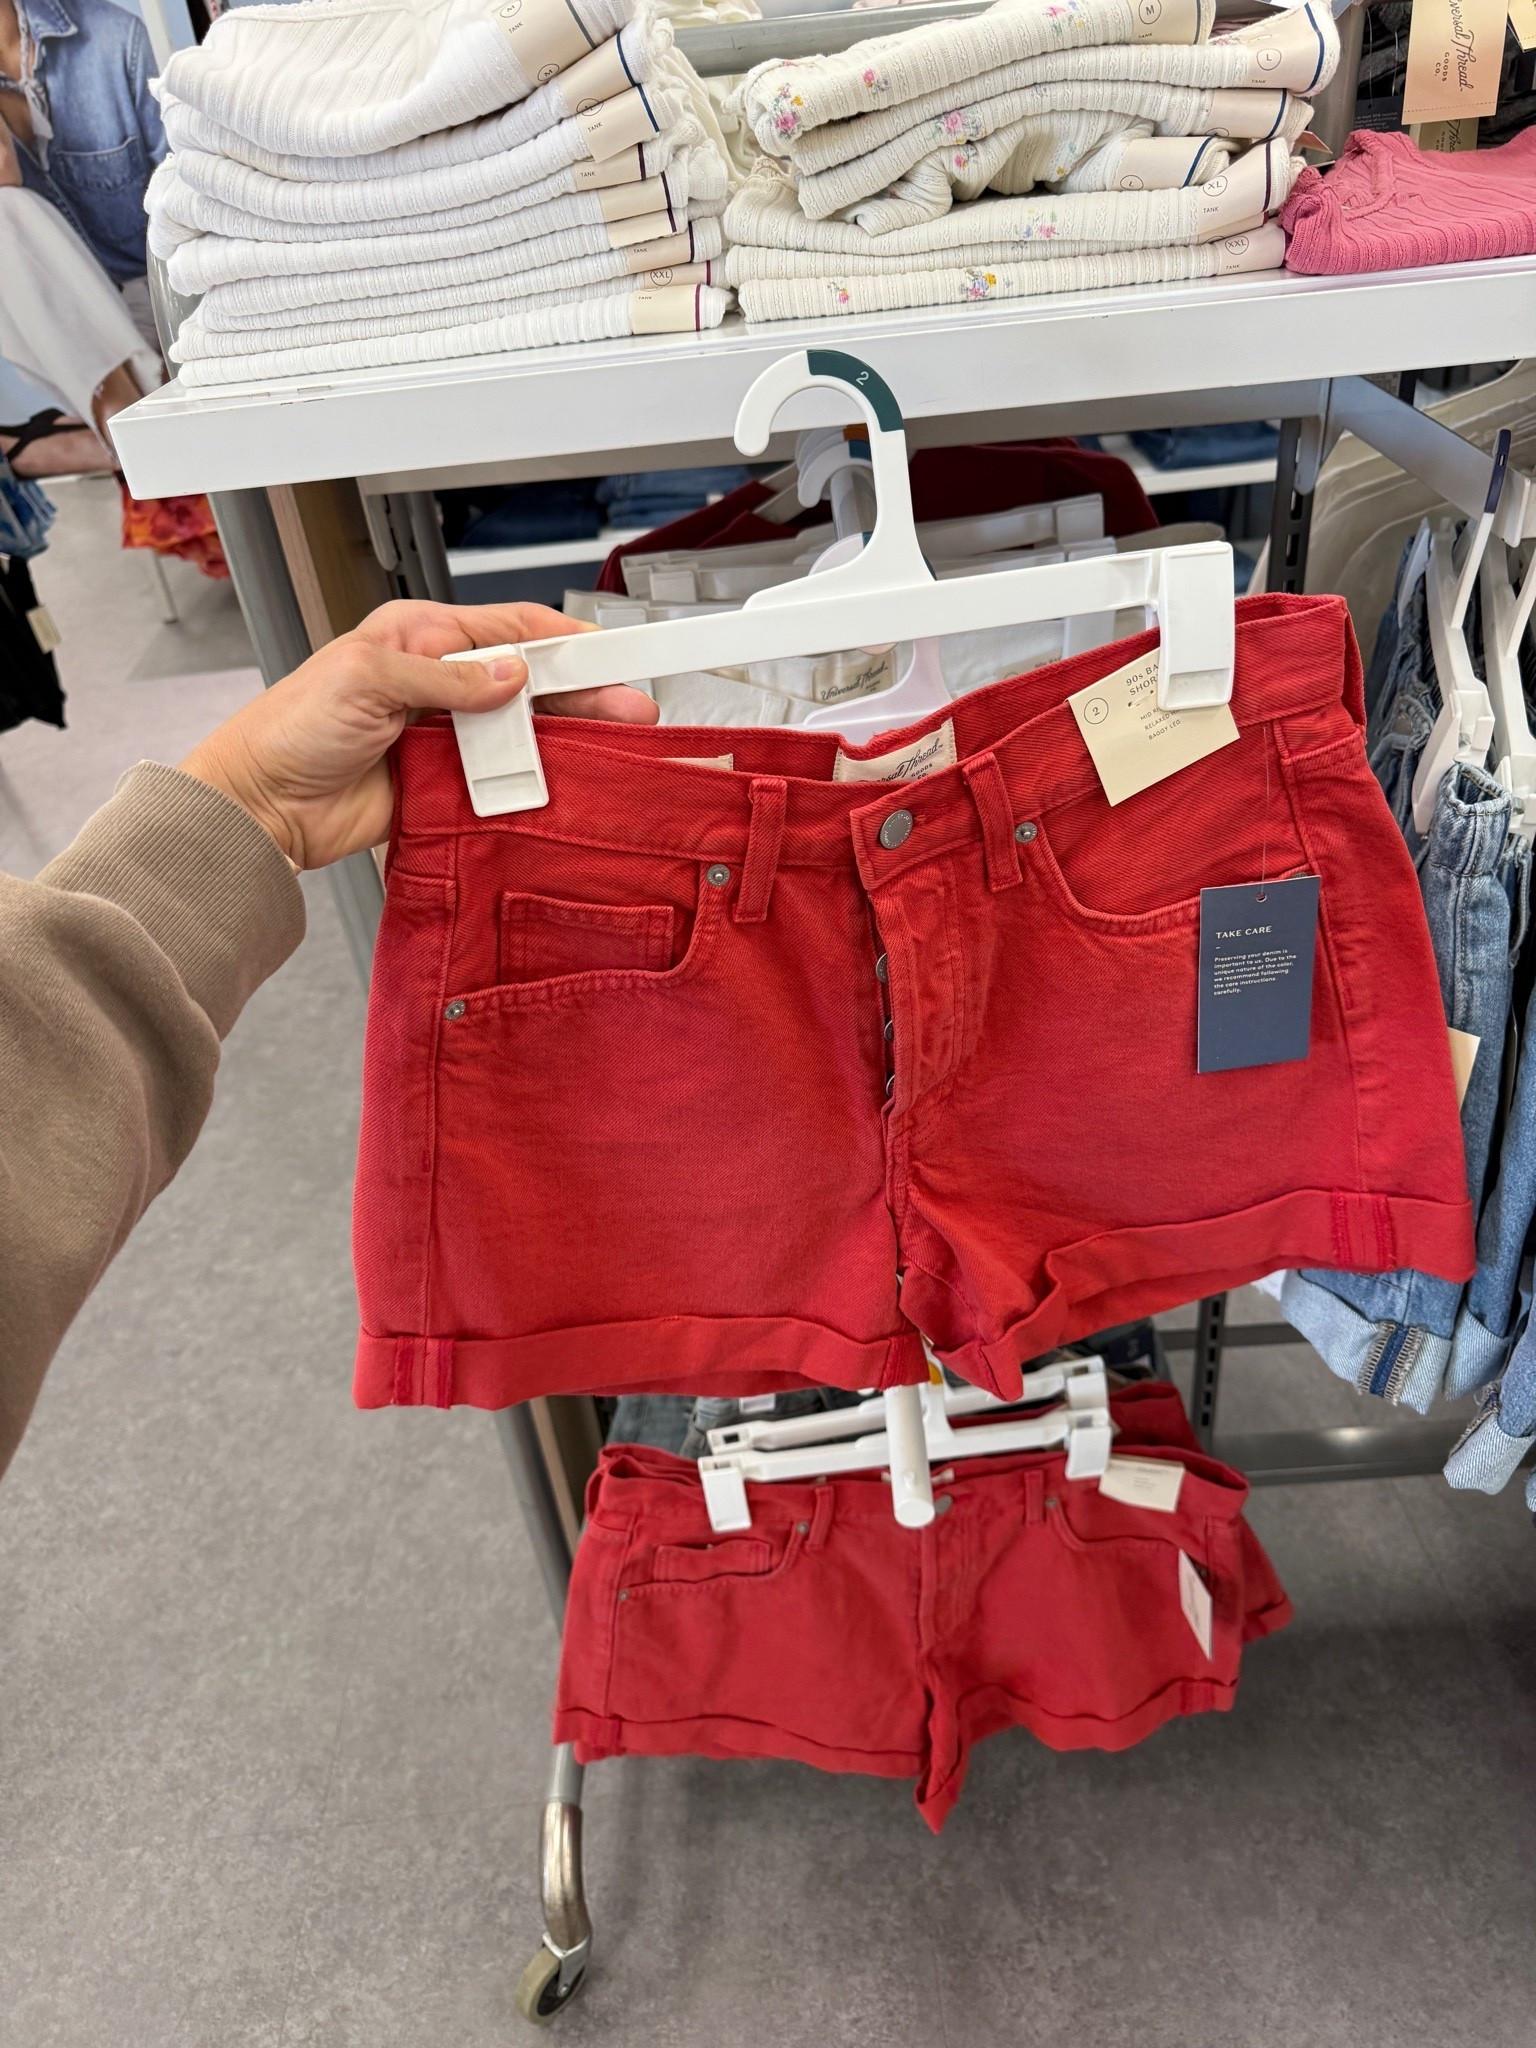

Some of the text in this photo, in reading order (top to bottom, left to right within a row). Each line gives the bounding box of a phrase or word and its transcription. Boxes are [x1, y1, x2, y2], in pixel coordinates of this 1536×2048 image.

[1145, 5, 1155, 15] M
[509, 22, 523, 34] TANK
[1451, 30, 1475, 90] Thread
[1442, 52, 1450, 82] GOODS
[544, 69, 553, 77] M
[587, 122, 603, 133] TANK
[1208, 180, 1223, 189] XL
[1228, 239, 1247, 248] XXL
[652, 270, 671, 279] XXL
[856, 371, 869, 386] 2
[1126, 664, 1159, 686] 90s BA
[1129, 674, 1158, 696] SHOR
[1092, 706, 1100, 716] 2
[1140, 711, 1152, 721] MID
[1144, 713, 1170, 731] RELAXED
[1148, 719, 1181, 740] BAGGY LEG
[897, 738, 940, 778] Thread
[911, 763, 933, 777] GOODS
[1216, 926, 1272, 939] TAKE CARE
[1214, 954, 1246, 962] Preserving
[1224, 972, 1259, 980] recommend
[1214, 988, 1241, 996] carefully.
